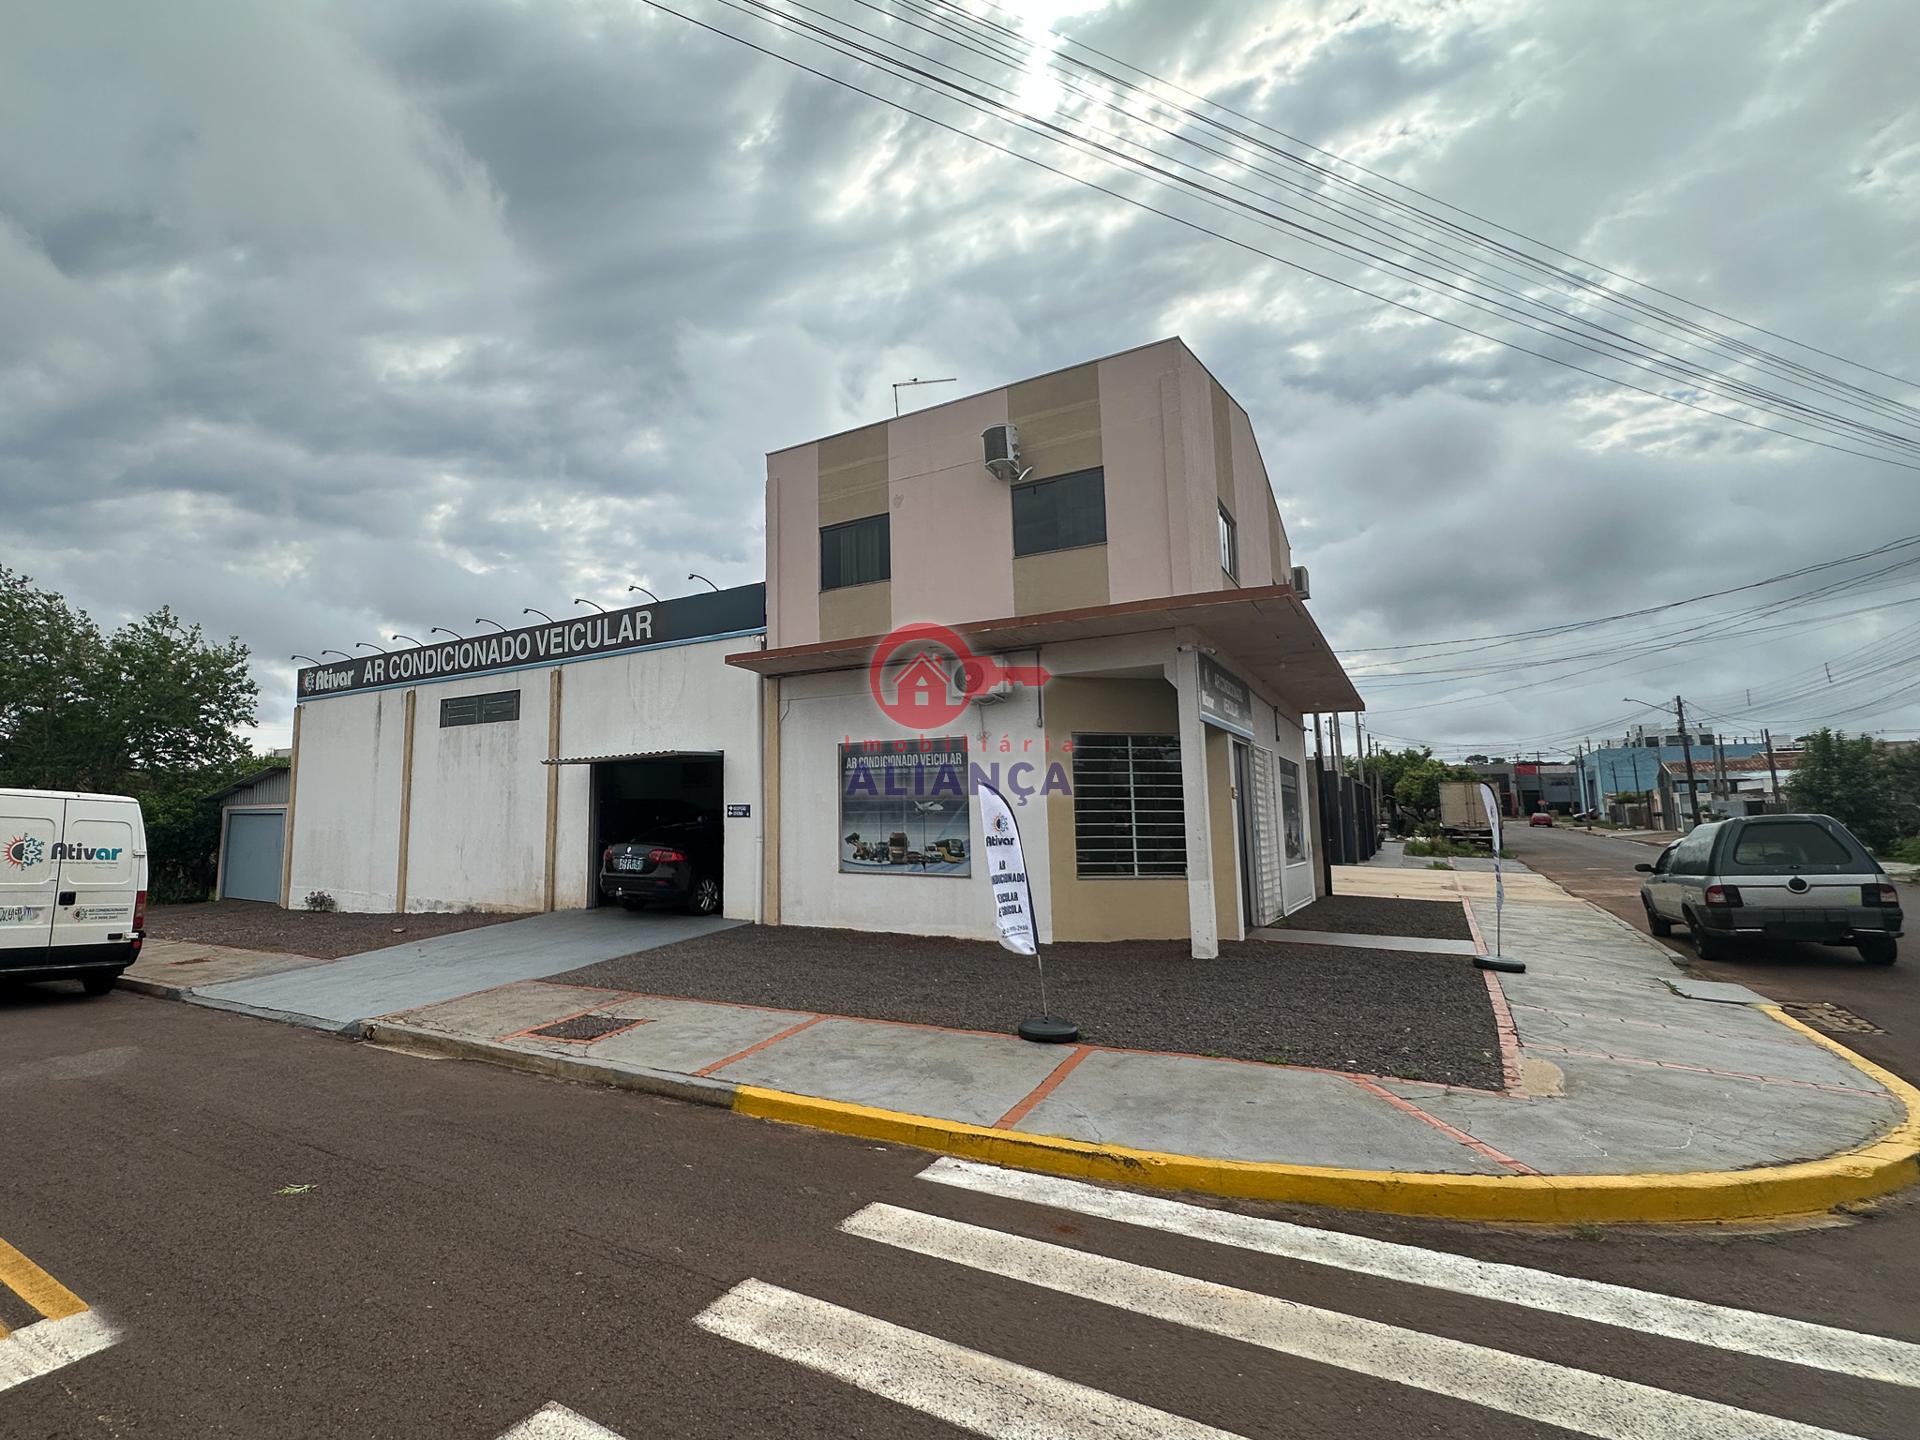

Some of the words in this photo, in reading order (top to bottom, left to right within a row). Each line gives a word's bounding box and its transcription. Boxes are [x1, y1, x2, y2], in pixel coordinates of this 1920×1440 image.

[315, 668, 355, 691] Ativar
[363, 659, 384, 683] AR
[389, 632, 531, 679] CONDICIONADO
[535, 610, 652, 656] VEICULAR
[846, 757, 857, 769] AR
[858, 754, 918, 768] CONDICIONADO
[919, 752, 962, 766] VEICULAR
[985, 835, 1015, 847] Ativar
[51, 842, 123, 861] Ativar
